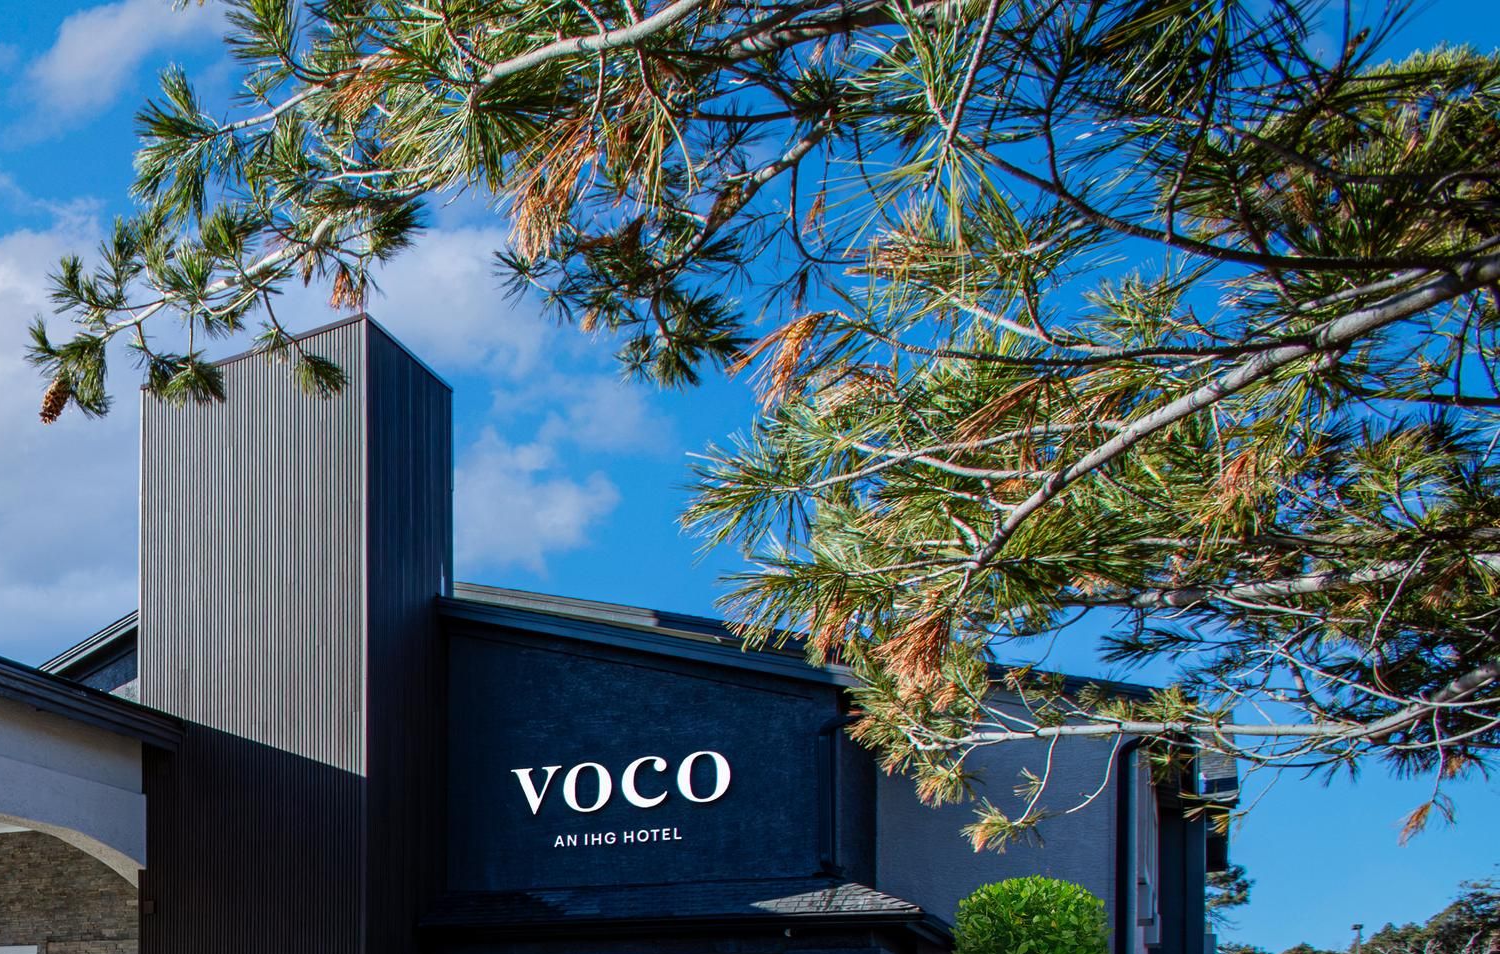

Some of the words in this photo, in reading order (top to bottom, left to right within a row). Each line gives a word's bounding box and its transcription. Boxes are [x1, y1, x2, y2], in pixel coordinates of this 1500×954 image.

[553, 834, 578, 848] AN
[583, 831, 617, 846] IHG
[623, 827, 683, 844] HOTEL
